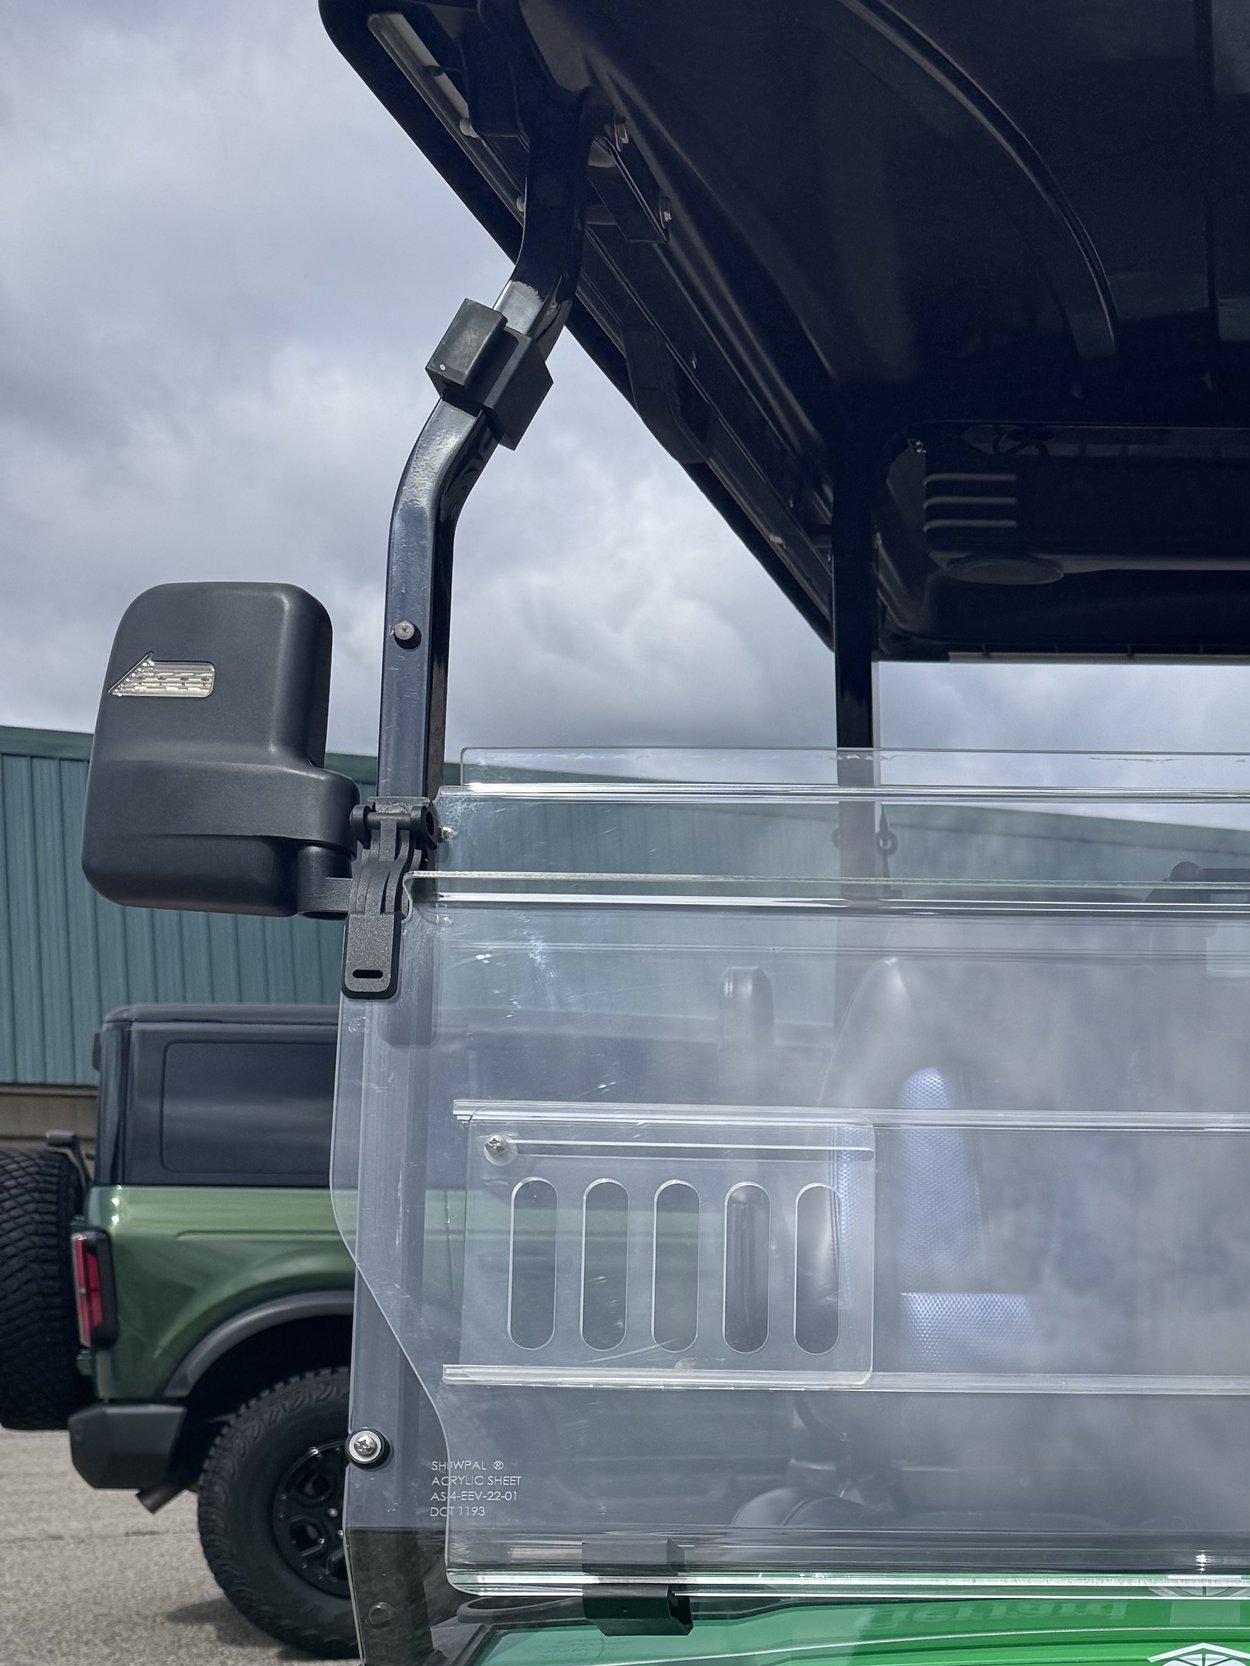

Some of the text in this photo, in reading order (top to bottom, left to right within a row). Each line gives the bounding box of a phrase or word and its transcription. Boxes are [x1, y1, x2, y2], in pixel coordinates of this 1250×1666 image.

[431, 1460, 487, 1470] SHOWPAL
[431, 1475, 522, 1486] ACRYLIC SHEET
[459, 1506, 486, 1516] 1193
